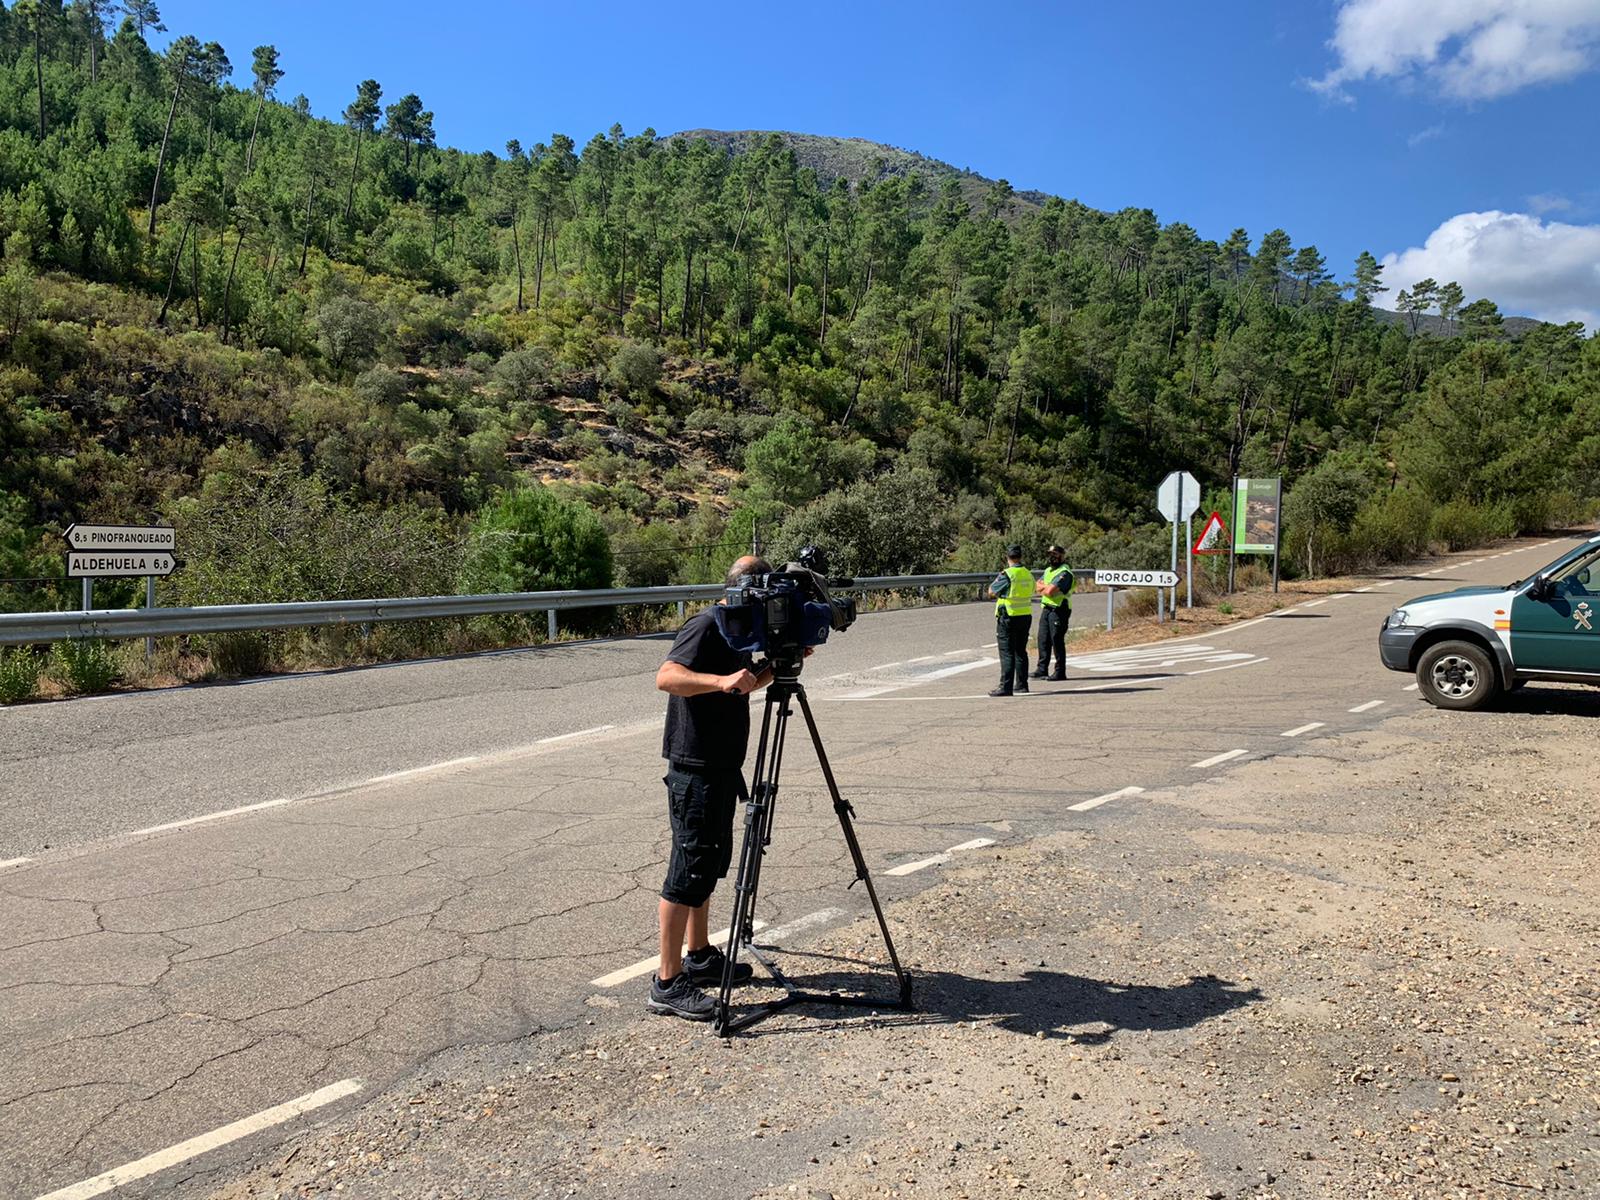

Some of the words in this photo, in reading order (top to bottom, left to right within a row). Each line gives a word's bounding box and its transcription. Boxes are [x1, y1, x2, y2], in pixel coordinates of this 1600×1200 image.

[91, 533, 172, 543] PINOFRANQUEADO
[72, 559, 146, 570] ALDEHUELA
[1097, 573, 1153, 583] HORCAJO
